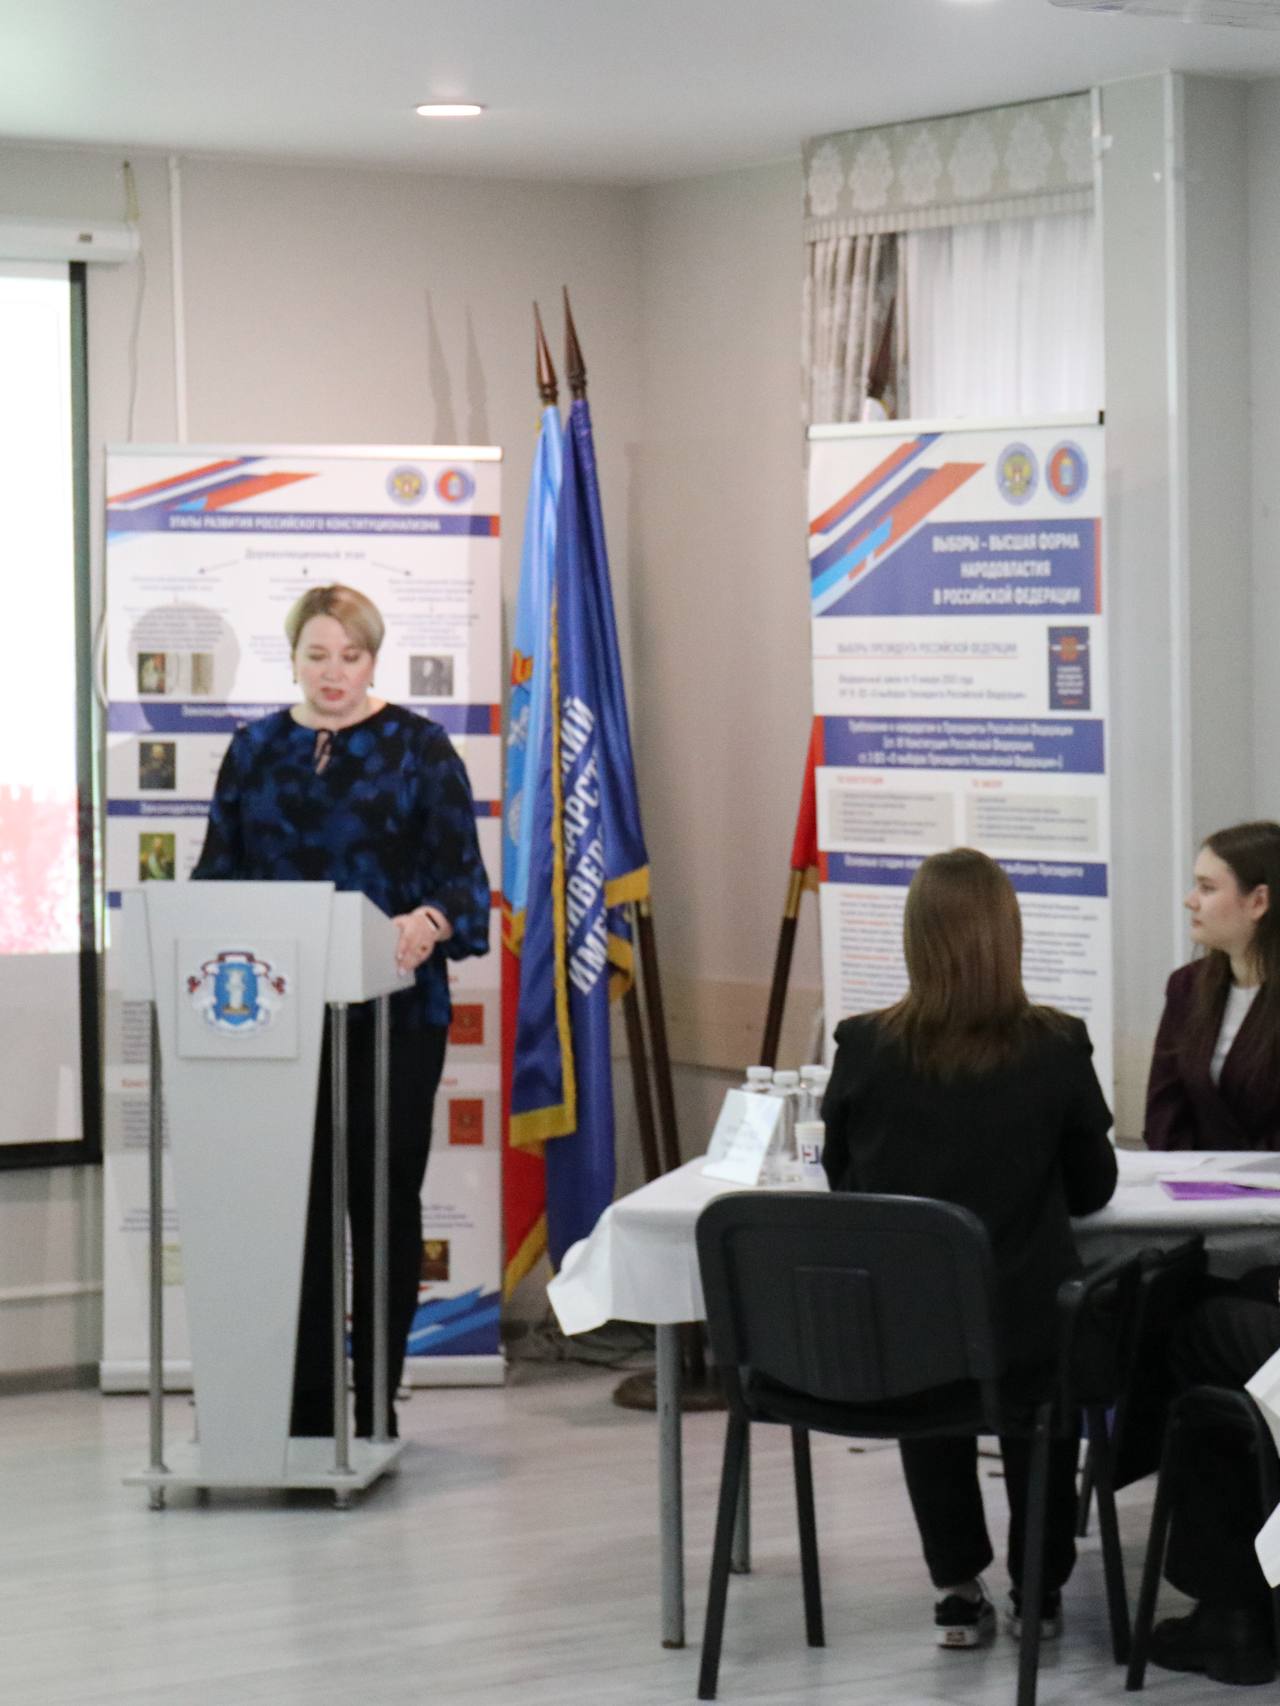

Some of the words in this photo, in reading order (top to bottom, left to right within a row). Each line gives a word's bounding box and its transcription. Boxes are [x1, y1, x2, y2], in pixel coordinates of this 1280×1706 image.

[169, 516, 201, 529] ЭТАПЫ
[204, 516, 252, 530] РАЗВИТИЯ
[255, 516, 323, 531] РОССИЙСКОГО
[326, 518, 441, 532] КОНСТИТУЦИОНАЛИЗМА
[932, 535, 980, 552] ВЫБОРЫ
[989, 533, 1037, 551] ВЫСШАЯ
[1038, 532, 1080, 550] ФОРМА
[960, 560, 1051, 579] НАРОДОВЛАСТИЯ
[933, 588, 941, 606] В
[943, 585, 1013, 606] РОССИЙСКОЙ
[1014, 587, 1081, 606] ФЕДЕРАЦИИ
[568, 905, 609, 997] ИМЕ
